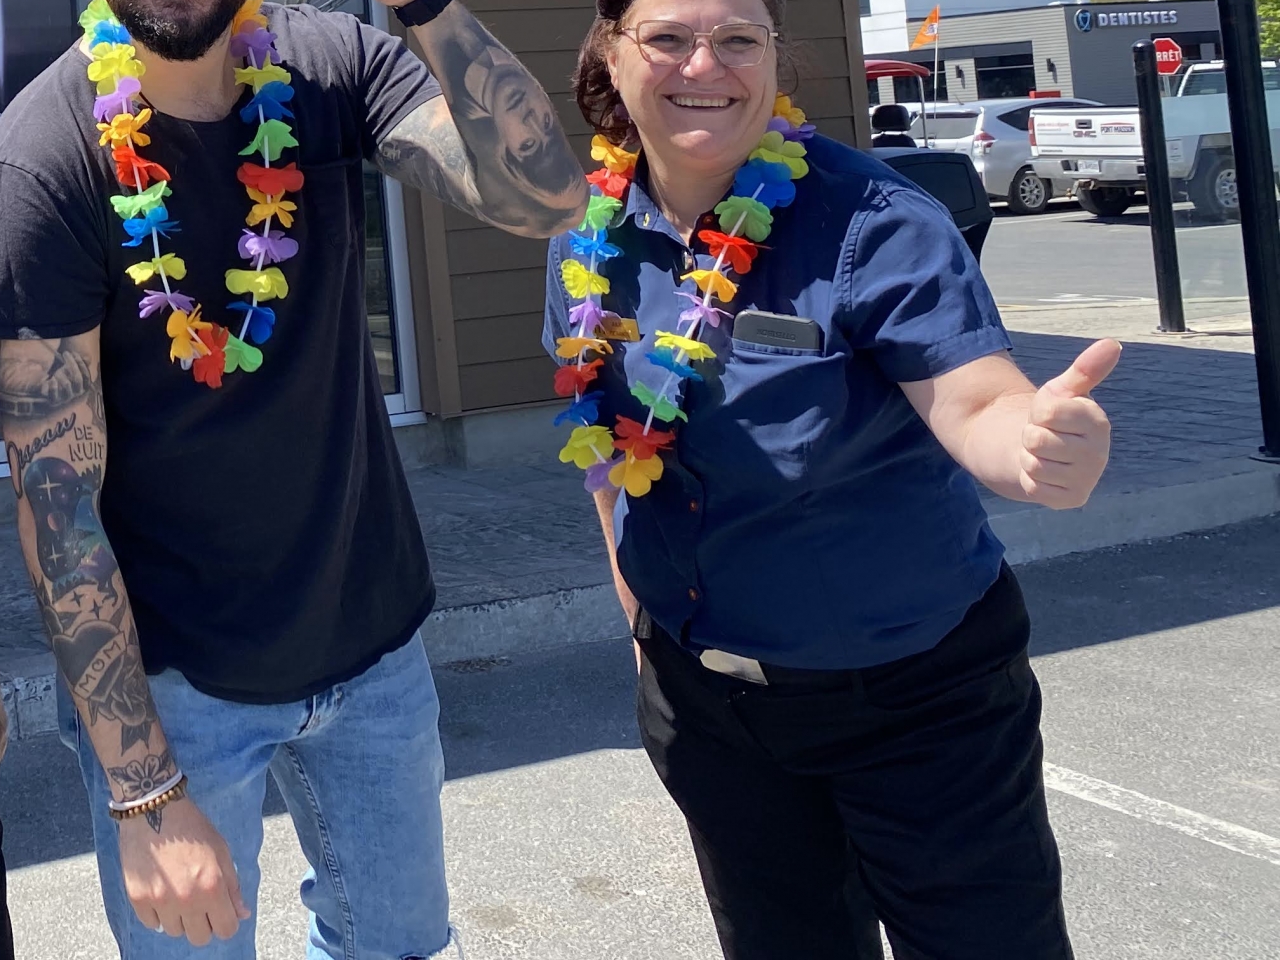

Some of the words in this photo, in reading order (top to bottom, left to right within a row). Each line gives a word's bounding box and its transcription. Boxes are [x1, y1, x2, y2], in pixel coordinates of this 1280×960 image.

[1098, 10, 1177, 26] DENTISTES
[1156, 49, 1179, 61] RRÊT
[74, 425, 93, 440] DE
[69, 442, 104, 462] NUIT
[79, 640, 121, 693] MOM
